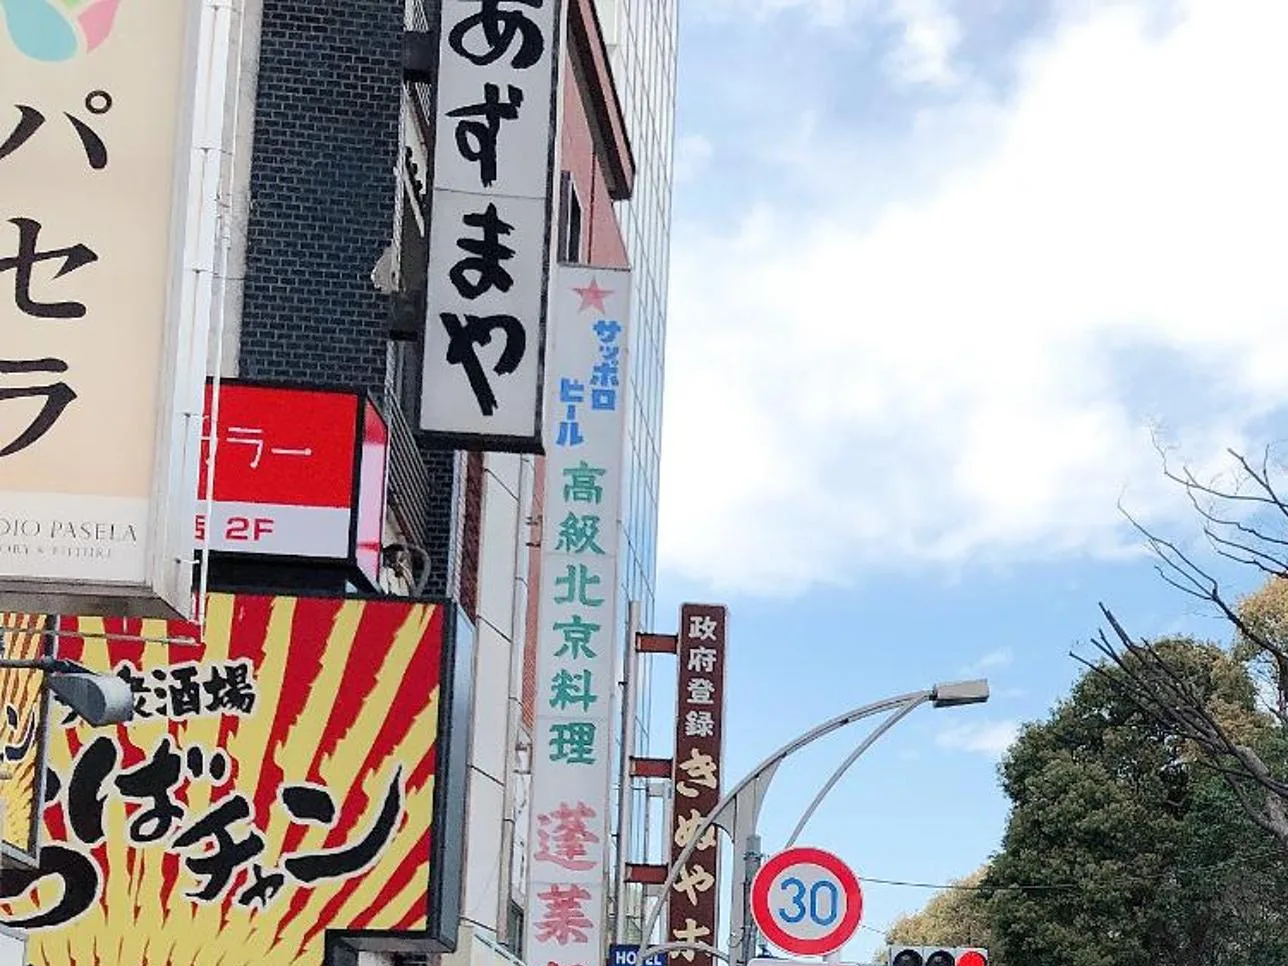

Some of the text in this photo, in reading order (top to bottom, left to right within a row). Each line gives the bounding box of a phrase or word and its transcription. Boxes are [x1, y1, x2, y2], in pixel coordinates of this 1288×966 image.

[439, 0, 545, 416] あずまや
[0, 90, 113, 457] パセラ
[589, 319, 622, 411] サッポロ
[556, 377, 584, 446] ビール
[51, 520, 136, 541] PASELA
[225, 517, 274, 541] 2F
[549, 460, 606, 765] 高級北京料理
[684, 615, 717, 737] 政府登録
[778, 877, 838, 926] 30
[615, 951, 662, 965] HOEL
